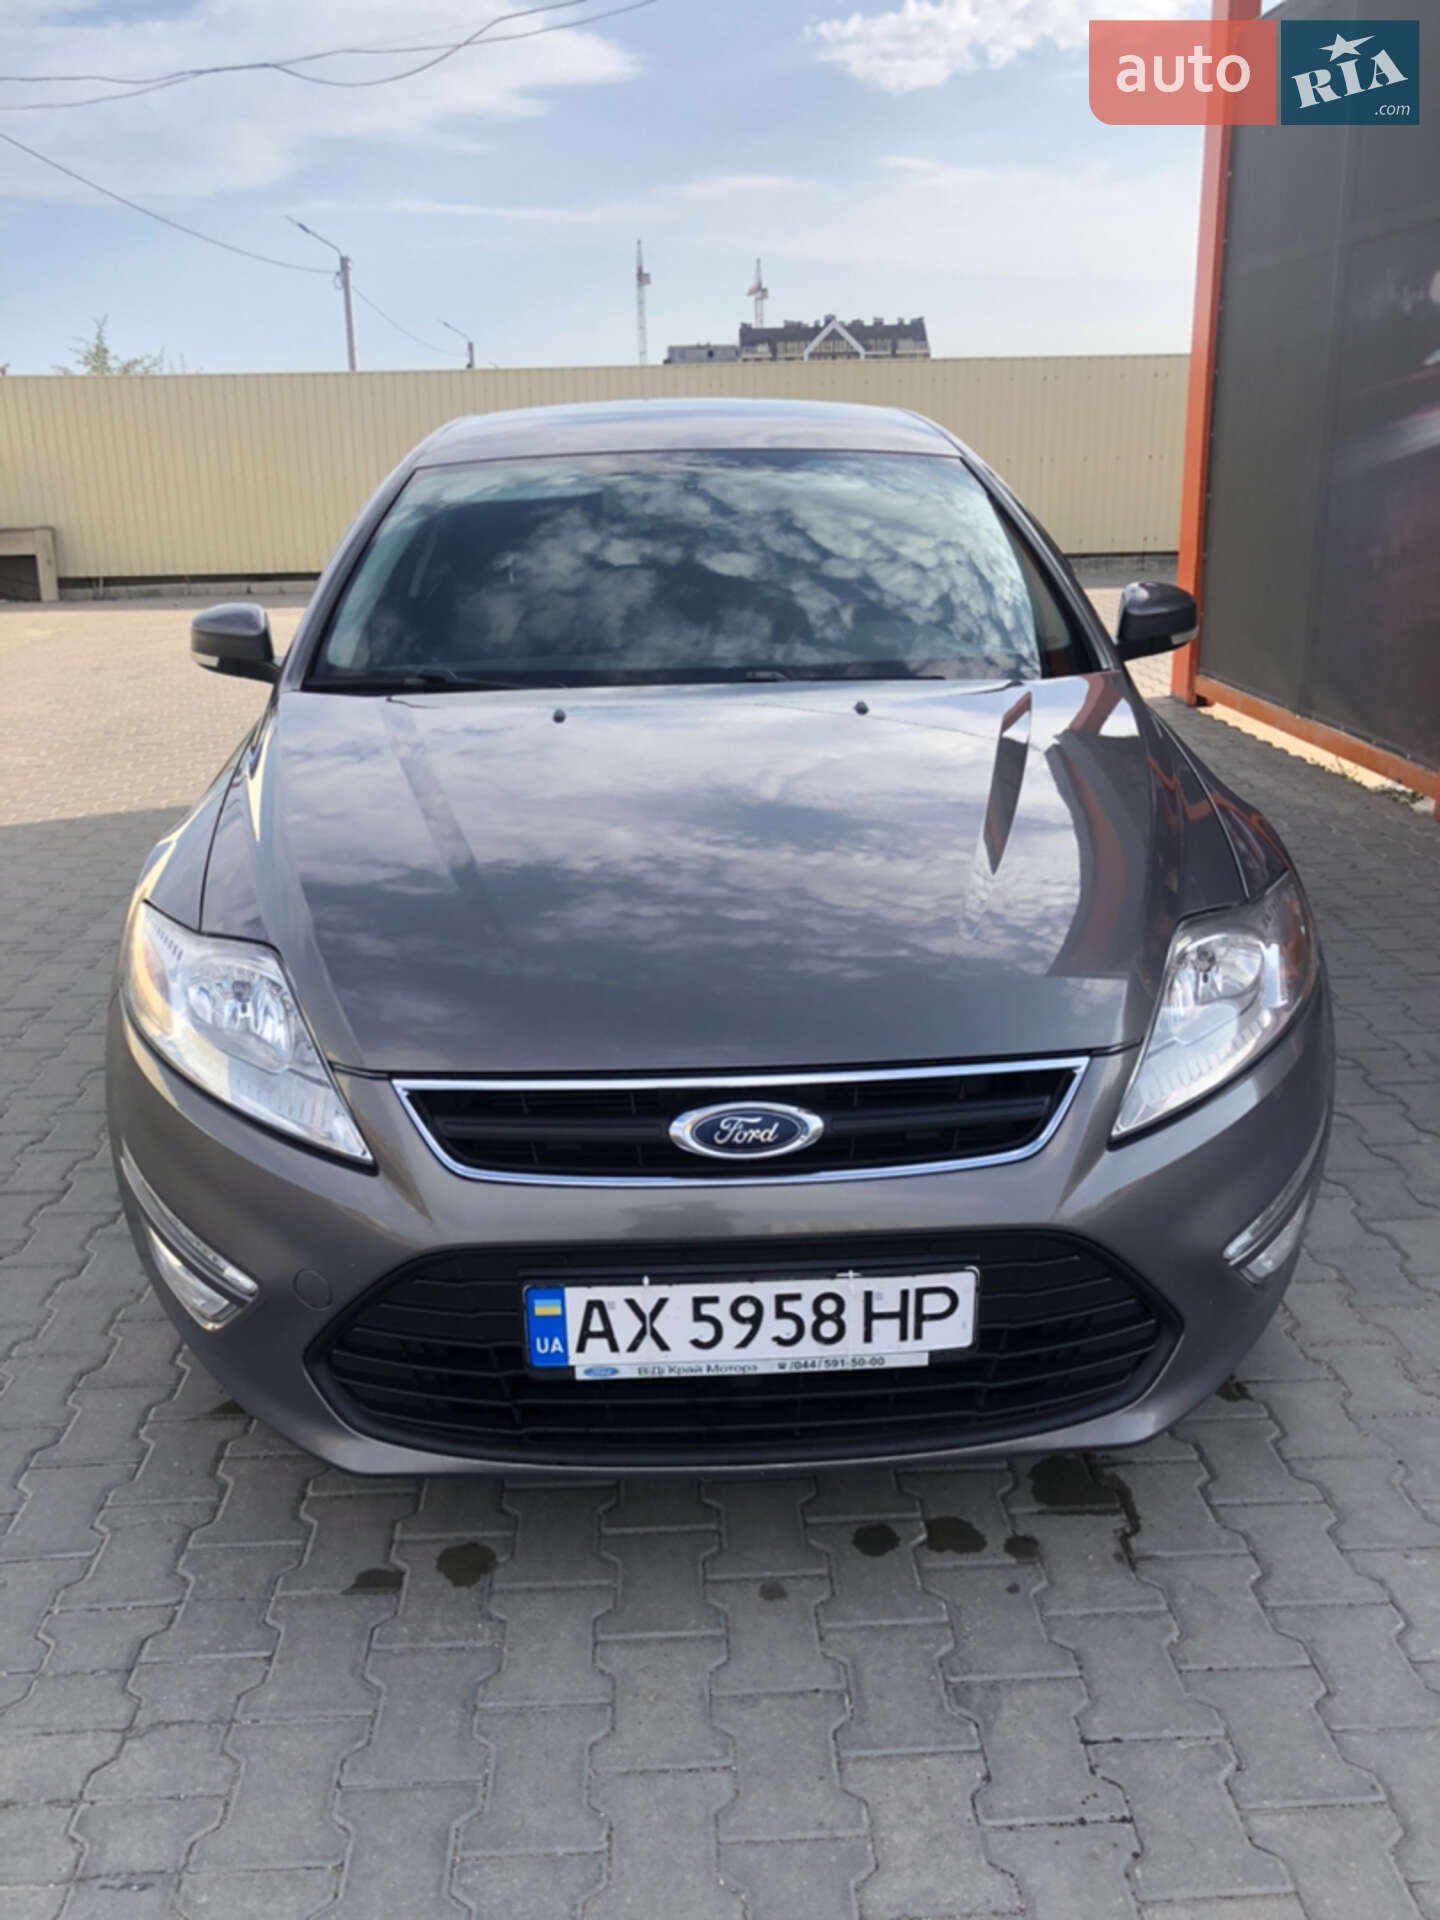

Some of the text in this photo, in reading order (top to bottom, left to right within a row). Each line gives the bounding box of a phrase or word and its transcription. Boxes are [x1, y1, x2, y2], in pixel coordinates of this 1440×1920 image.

[713, 1116, 780, 1144] Ford
[575, 1286, 959, 1353] AX 5958 HP
[536, 1337, 564, 1354] UA
